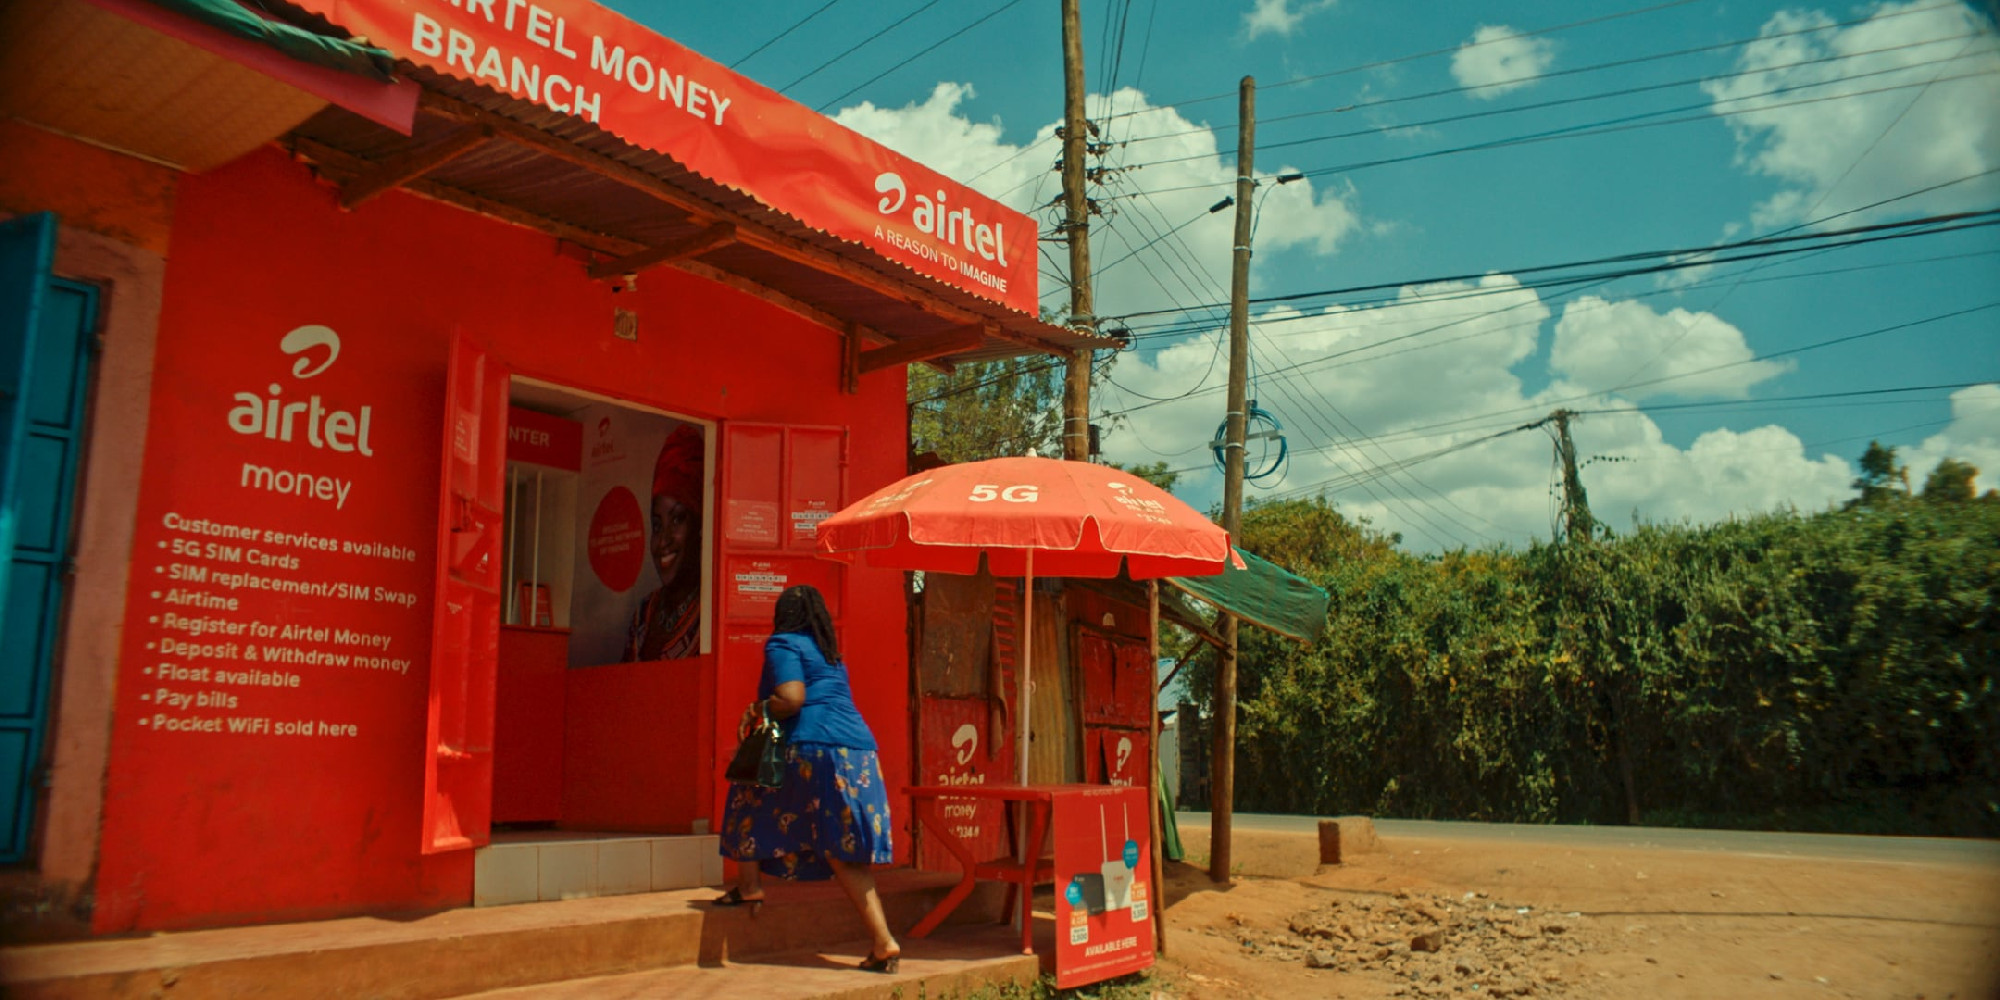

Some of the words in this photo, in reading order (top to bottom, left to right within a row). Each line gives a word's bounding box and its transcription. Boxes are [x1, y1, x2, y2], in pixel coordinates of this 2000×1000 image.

[411, 12, 600, 123] BRANCH
[591, 35, 731, 126] MONEY
[912, 189, 1008, 268] airtel
[874, 225, 885, 240] A
[886, 229, 938, 262] REASON
[941, 252, 957, 270] TO
[960, 261, 1007, 293] IMAGINE
[228, 383, 373, 457] airtel
[508, 425, 551, 448] NTER
[241, 462, 351, 509] money
[968, 484, 1039, 502] 5G
[163, 512, 261, 540] Customer
[263, 530, 338, 551] services
[343, 540, 416, 562] available
[171, 538, 201, 557] 5G
[205, 542, 241, 563] SIM
[246, 549, 300, 570] Cards
[164, 588, 239, 611] Airtime
[168, 562, 207, 582] SIM
[211, 571, 370, 600] replacement/SIM
[374, 586, 417, 608] Swap
[162, 612, 247, 636] Register
[250, 621, 277, 638] for
[280, 624, 329, 642] Airtel
[334, 629, 391, 651] Money
[157, 662, 210, 682] Float
[214, 669, 300, 688] available
[160, 637, 238, 661] Deposit
[243, 644, 258, 661] &
[262, 645, 350, 666] Withdraw
[353, 654, 411, 675] money
[155, 688, 193, 710] Pay
[196, 690, 238, 709] bills
[152, 713, 223, 732] Pocket
[227, 717, 270, 735] WiFi
[274, 720, 313, 736] sold
[318, 720, 358, 737] here
[1085, 940, 1122, 958] AVAILABLE
[1122, 936, 1137, 950] HERE
